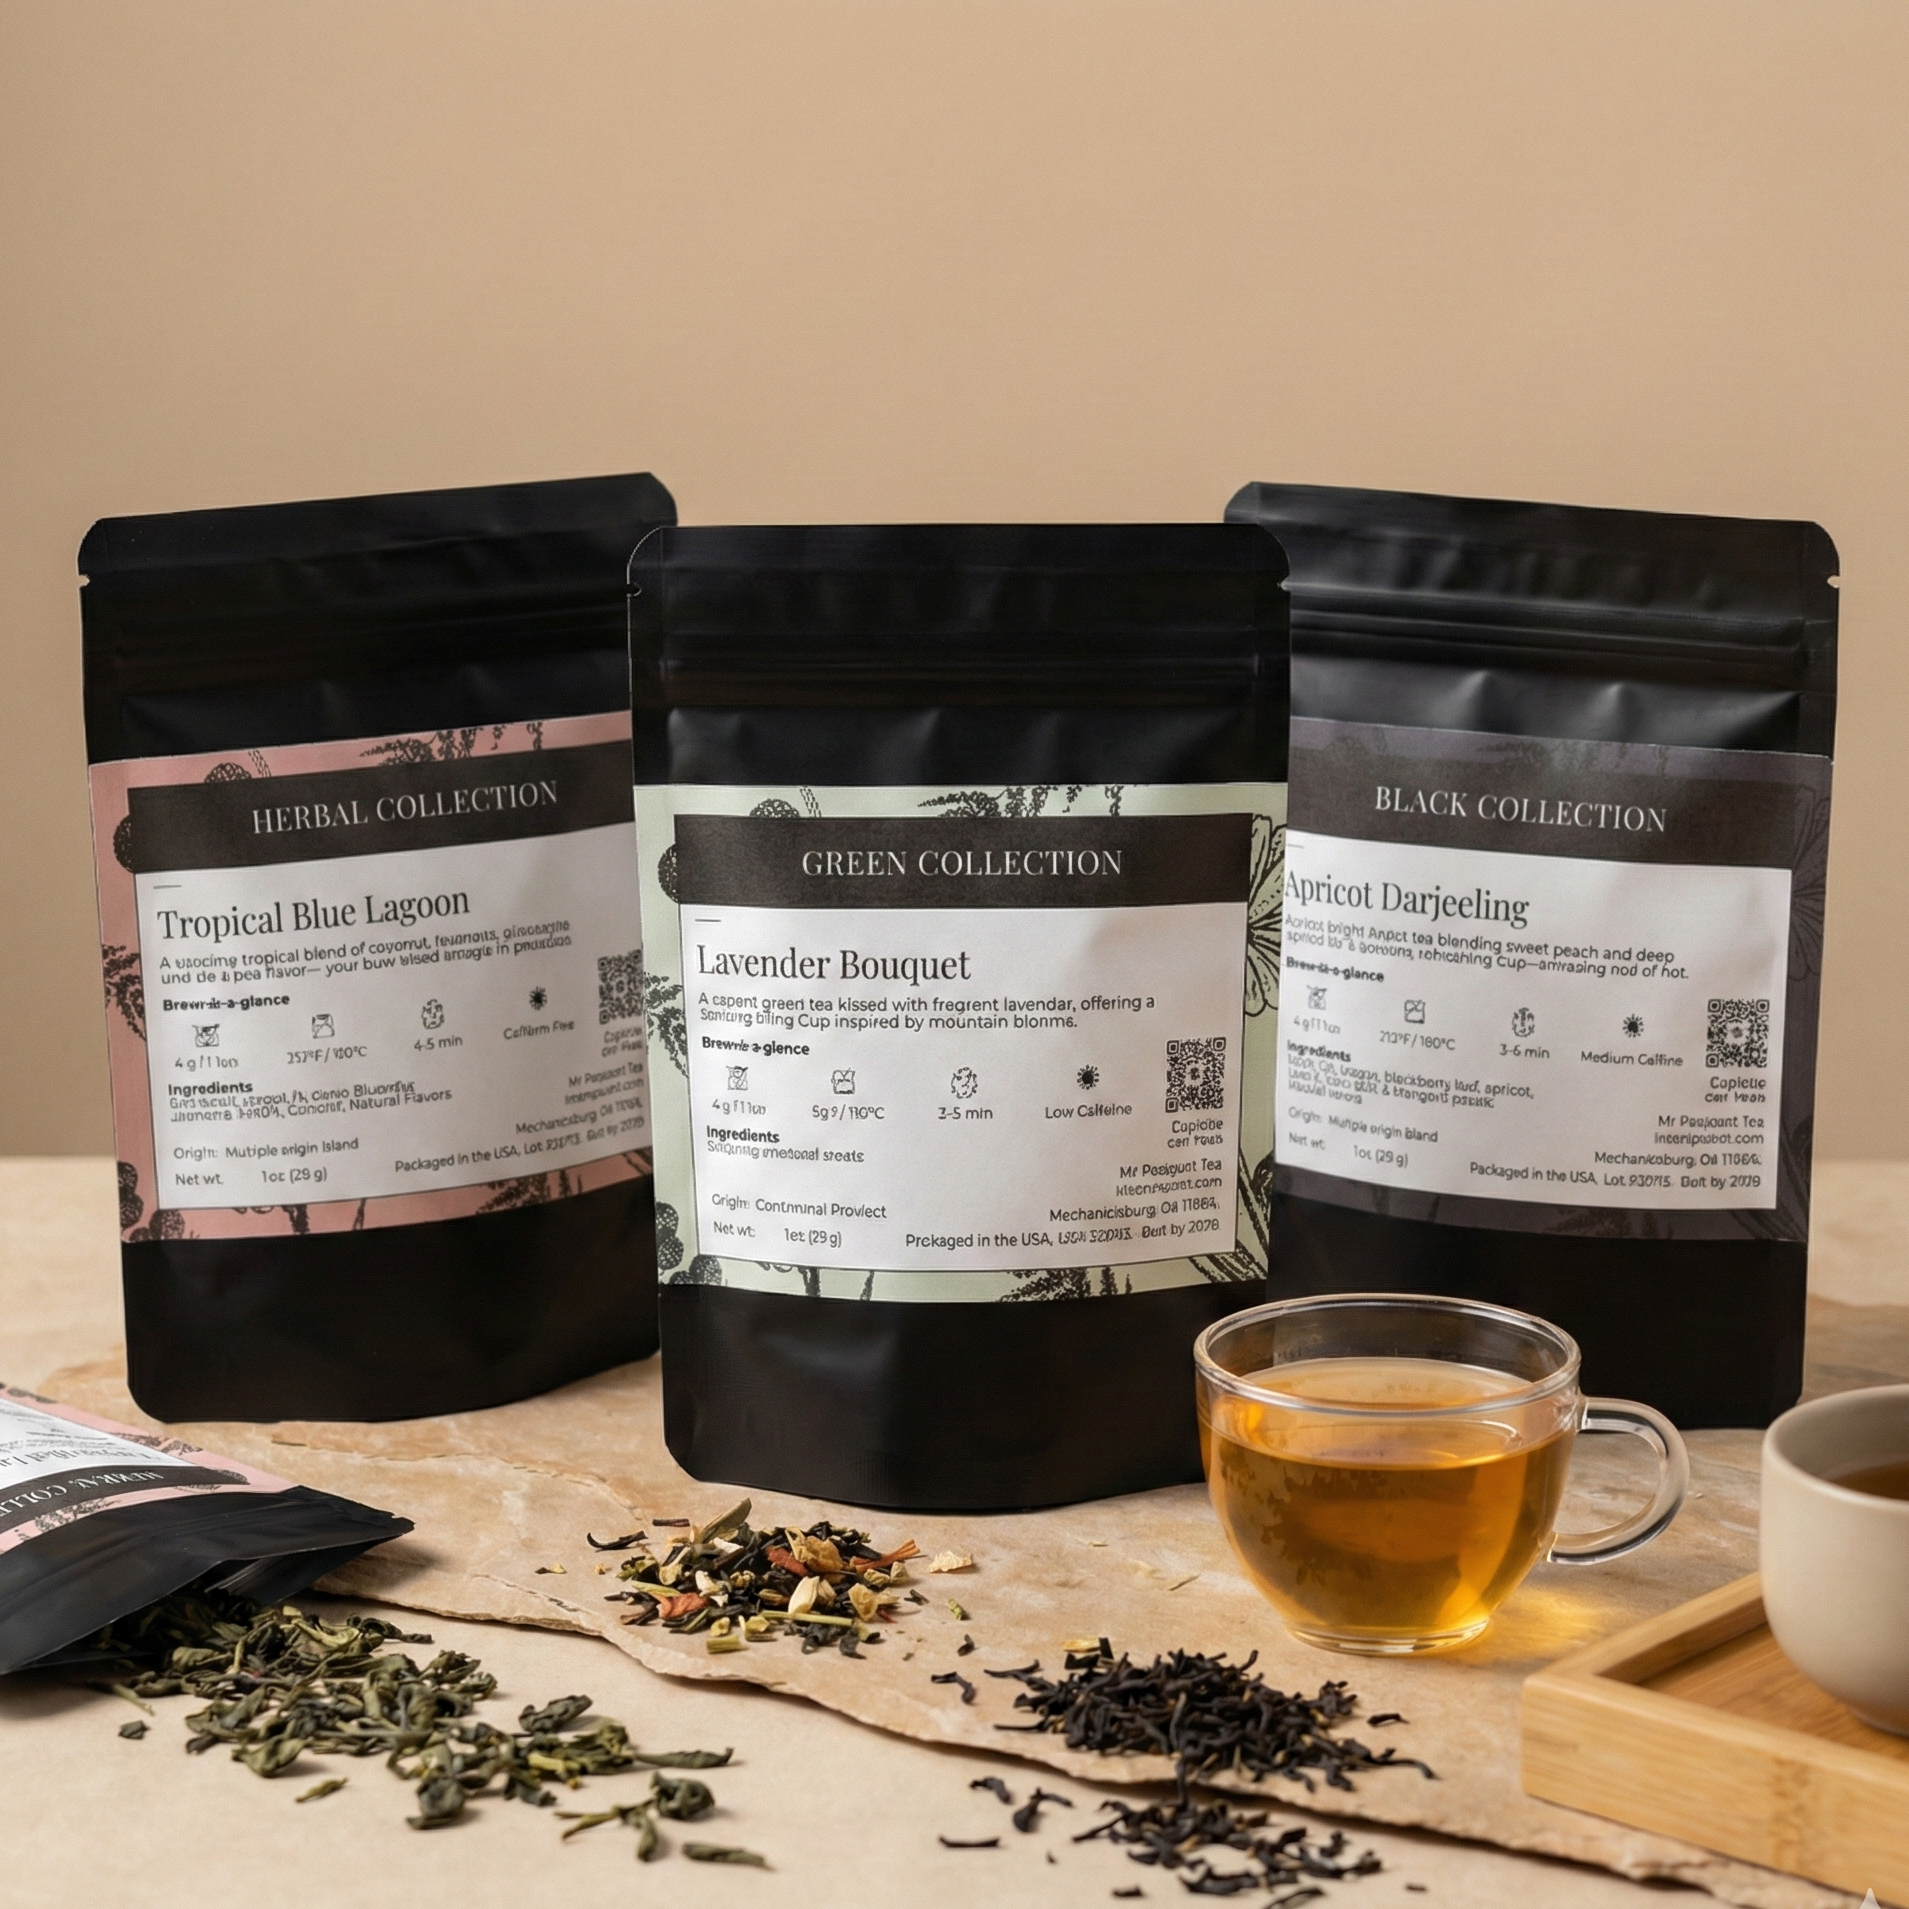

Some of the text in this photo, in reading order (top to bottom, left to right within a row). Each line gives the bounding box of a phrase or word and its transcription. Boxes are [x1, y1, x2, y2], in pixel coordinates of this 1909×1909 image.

[252, 780, 558, 834] HERBAL COLLECTION
[1375, 786, 1668, 833] BLACK COLLECTION
[802, 850, 1122, 876] GREEN COLLECTION
[1285, 870, 1530, 930] Apricot Darjeeling
[157, 891, 470, 943] Tropical Blue Lagoon
[160, 956, 171, 969] A
[242, 949, 299, 968] tropical
[351, 941, 366, 956] of
[1438, 932, 1502, 955] blending
[1506, 941, 1549, 956] sweet
[1553, 945, 1599, 961] peach
[1603, 947, 1632, 961] and
[1636, 947, 1675, 966] deep
[161, 971, 191, 985] und
[234, 968, 261, 984] pea
[325, 960, 358, 978] your
[496, 942, 509, 956] in
[697, 944, 972, 986] Lavender Bouquet
[1642, 964, 1658, 978] of
[1661, 962, 1689, 979] hot.
[698, 992, 709, 1005] A
[762, 996, 804, 1014] green
[809, 998, 833, 1012] tea
[838, 997, 887, 1012] kissed
[892, 997, 928, 1012] with
[1003, 996, 1076, 1012] lavendar,
[1080, 994, 1142, 1012] offering
[1146, 996, 1155, 1009] a
[798, 1013, 830, 1031] Cup
[835, 1014, 899, 1032] inspired
[905, 1014, 925, 1032] by
[929, 1014, 1008, 1029] mountain
[438, 1034, 463, 1048] min
[175, 1056, 183, 1068] 4
[1524, 1046, 1550, 1060] min
[1581, 1050, 1635, 1066] Medium
[168, 1081, 253, 1098] Ingredients
[712, 1098, 720, 1110] 4
[966, 1107, 993, 1119] min
[1044, 1106, 1074, 1119] Low
[1658, 1114, 1676, 1127] Mr
[1743, 1115, 1765, 1128] Tea
[706, 1125, 780, 1143] Ingredients
[395, 1154, 455, 1172] Packaged
[458, 1151, 469, 1165] in
[472, 1148, 491, 1163] the
[494, 1144, 520, 1160] USA,
[1201, 1157, 1222, 1171] Tea
[1375, 1148, 1394, 1164] (29
[1396, 1153, 1409, 1170] g)
[175, 1173, 200, 1186] Net
[289, 1167, 311, 1184] (29
[314, 1166, 328, 1183] g)
[1532, 1166, 1543, 1180] in
[1546, 1169, 1567, 1182] the
[1710, 1175, 1727, 1190] by
[829, 1231, 843, 1249] g)
[977, 1233, 990, 1247] in
[994, 1233, 1018, 1247] the
[1021, 1232, 1053, 1248] USA,
[1170, 1223, 1186, 1237] by
